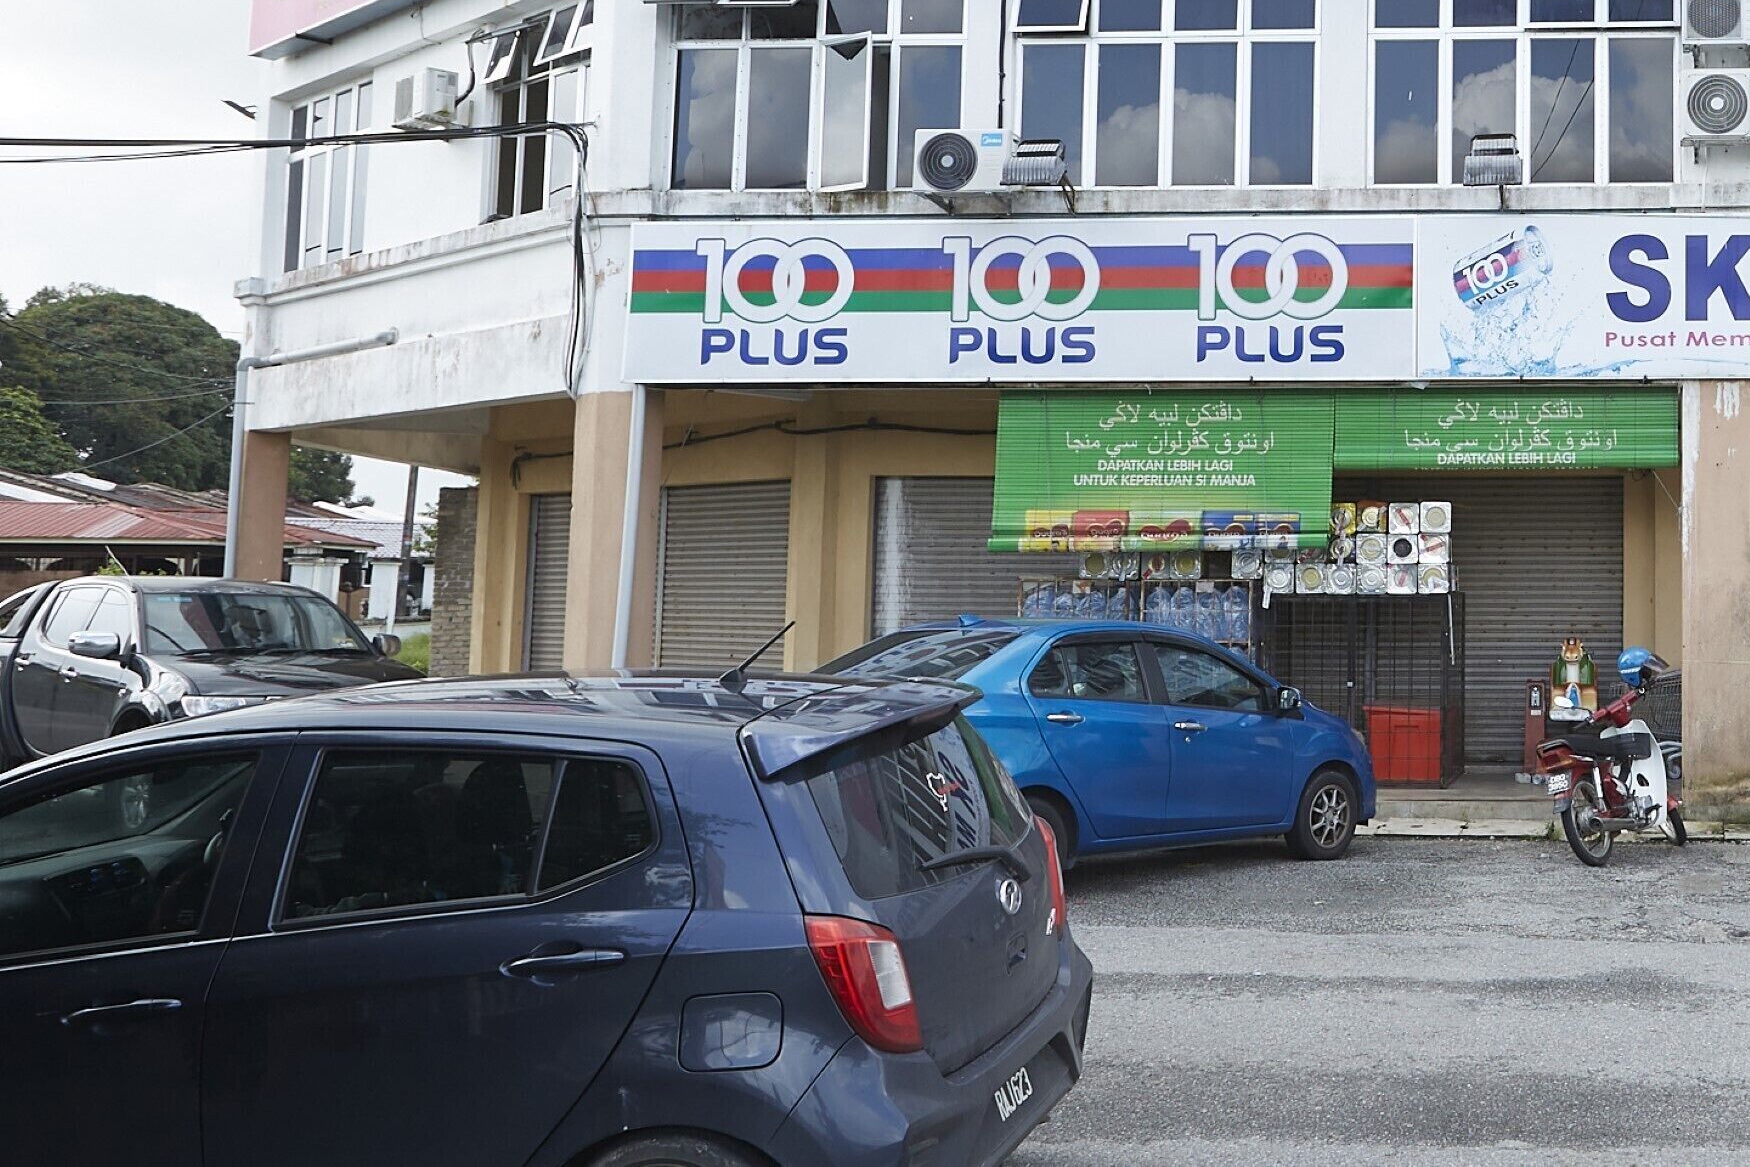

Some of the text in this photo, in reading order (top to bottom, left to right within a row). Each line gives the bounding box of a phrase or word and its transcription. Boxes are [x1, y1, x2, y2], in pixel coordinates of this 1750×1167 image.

[694, 236, 855, 324] 100
[942, 234, 1101, 322] 100
[1187, 232, 1349, 321] 100
[1475, 279, 1519, 305] PLUS
[701, 327, 849, 366] PLUS
[949, 326, 1096, 365] PLUS
[1196, 324, 1345, 363] PLUS
[1605, 331, 1679, 348] Pusat
[1097, 459, 1233, 471] DAPATKAN LEBIH LAGI
[1437, 452, 1577, 465] DAPATKAN LEBIH LAGI
[1073, 474, 1256, 487] UNTUK KEPERLUAN SI MANJA
